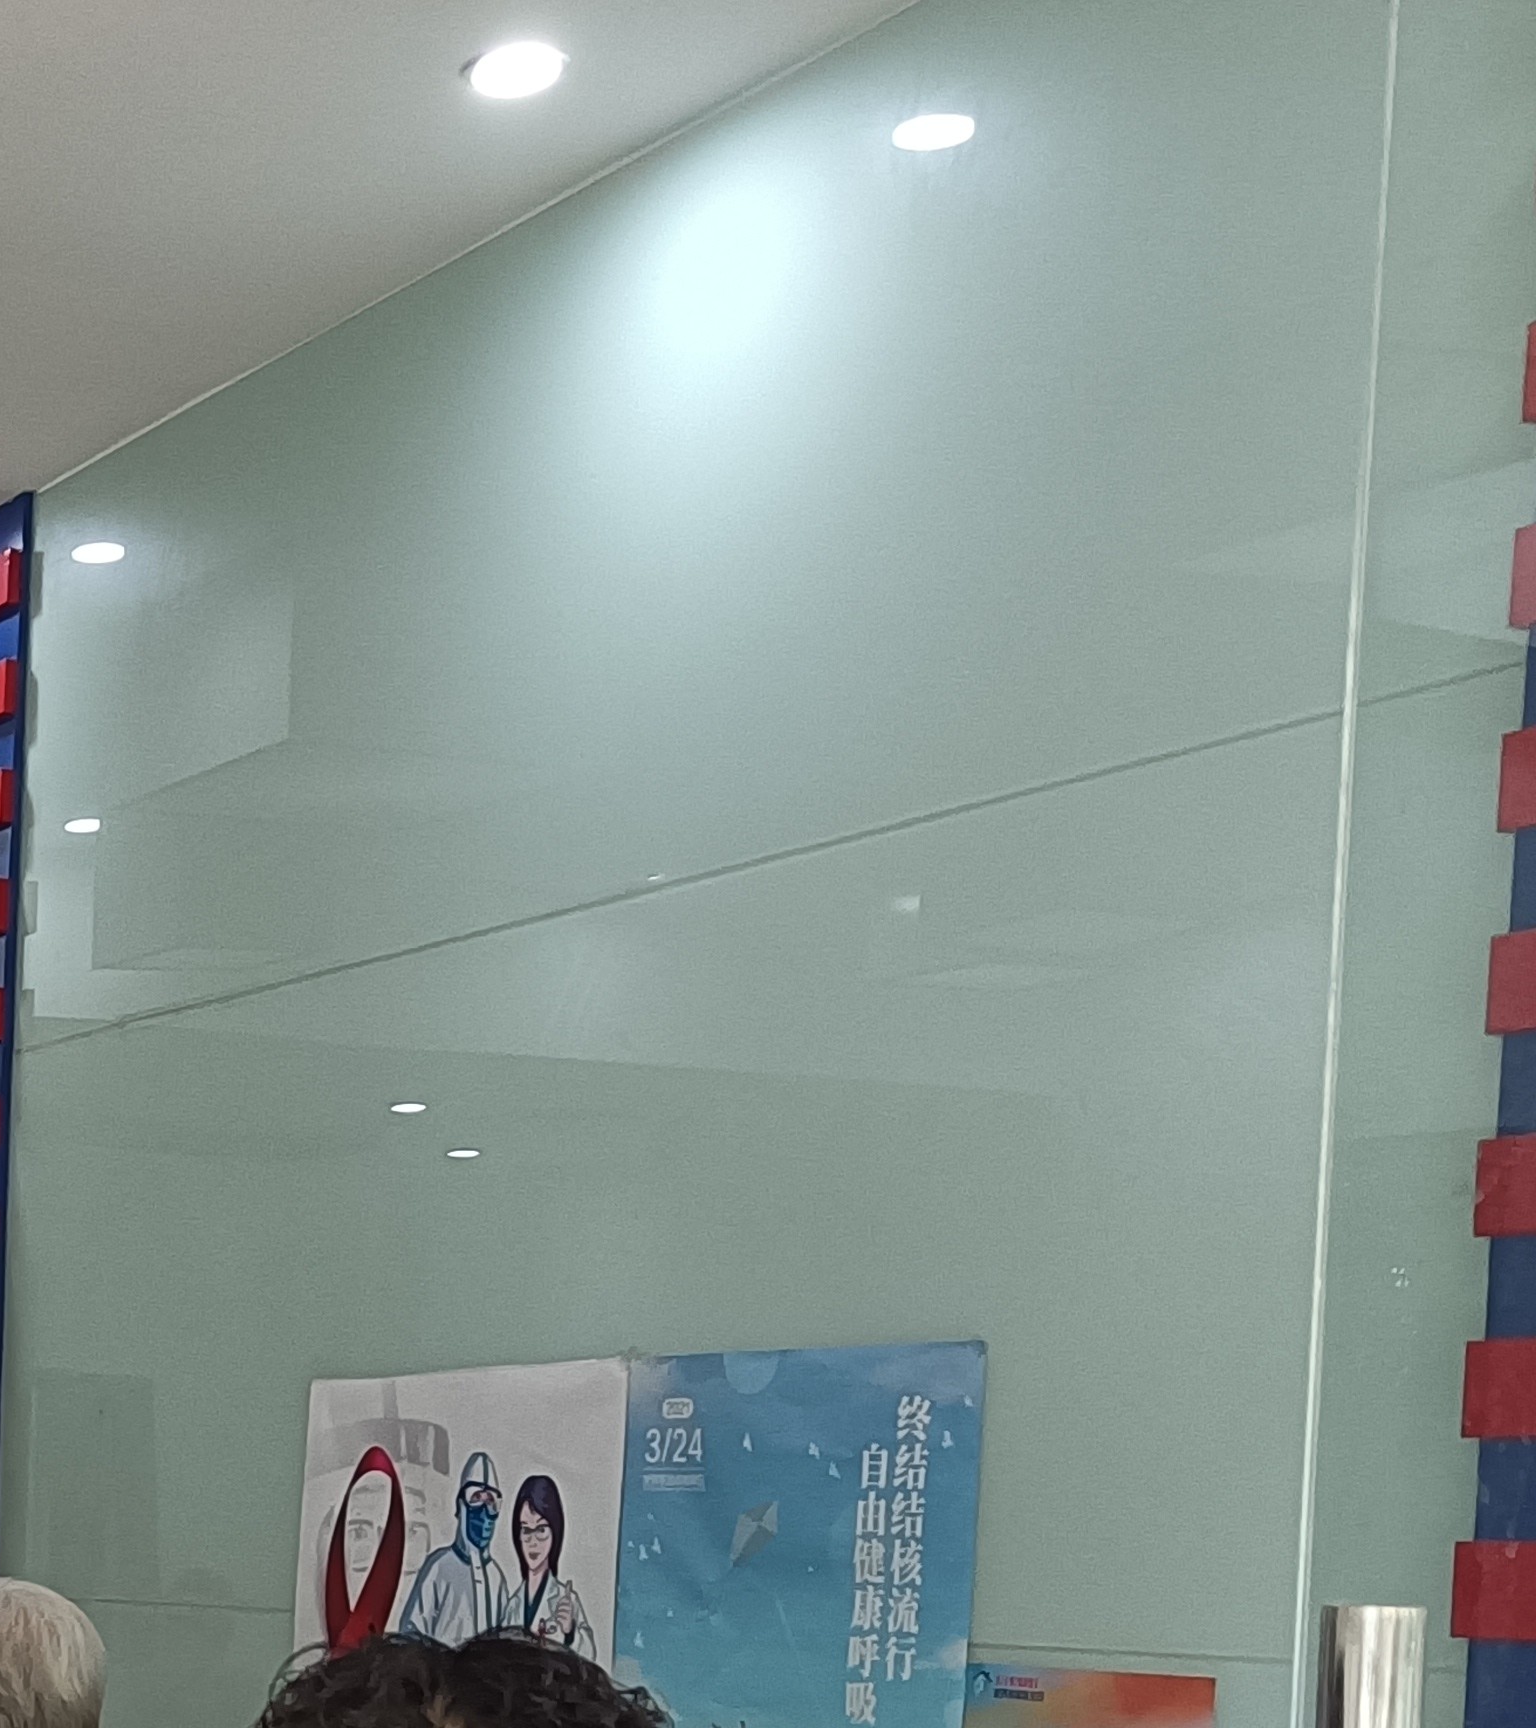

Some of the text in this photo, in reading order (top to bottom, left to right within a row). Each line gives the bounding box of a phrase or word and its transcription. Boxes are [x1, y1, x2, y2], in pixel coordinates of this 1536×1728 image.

[645, 1428, 702, 1463] 3/24
[845, 1443, 888, 1726] 自由健康呼吸
[885, 1395, 931, 1681] 终结结核流行
